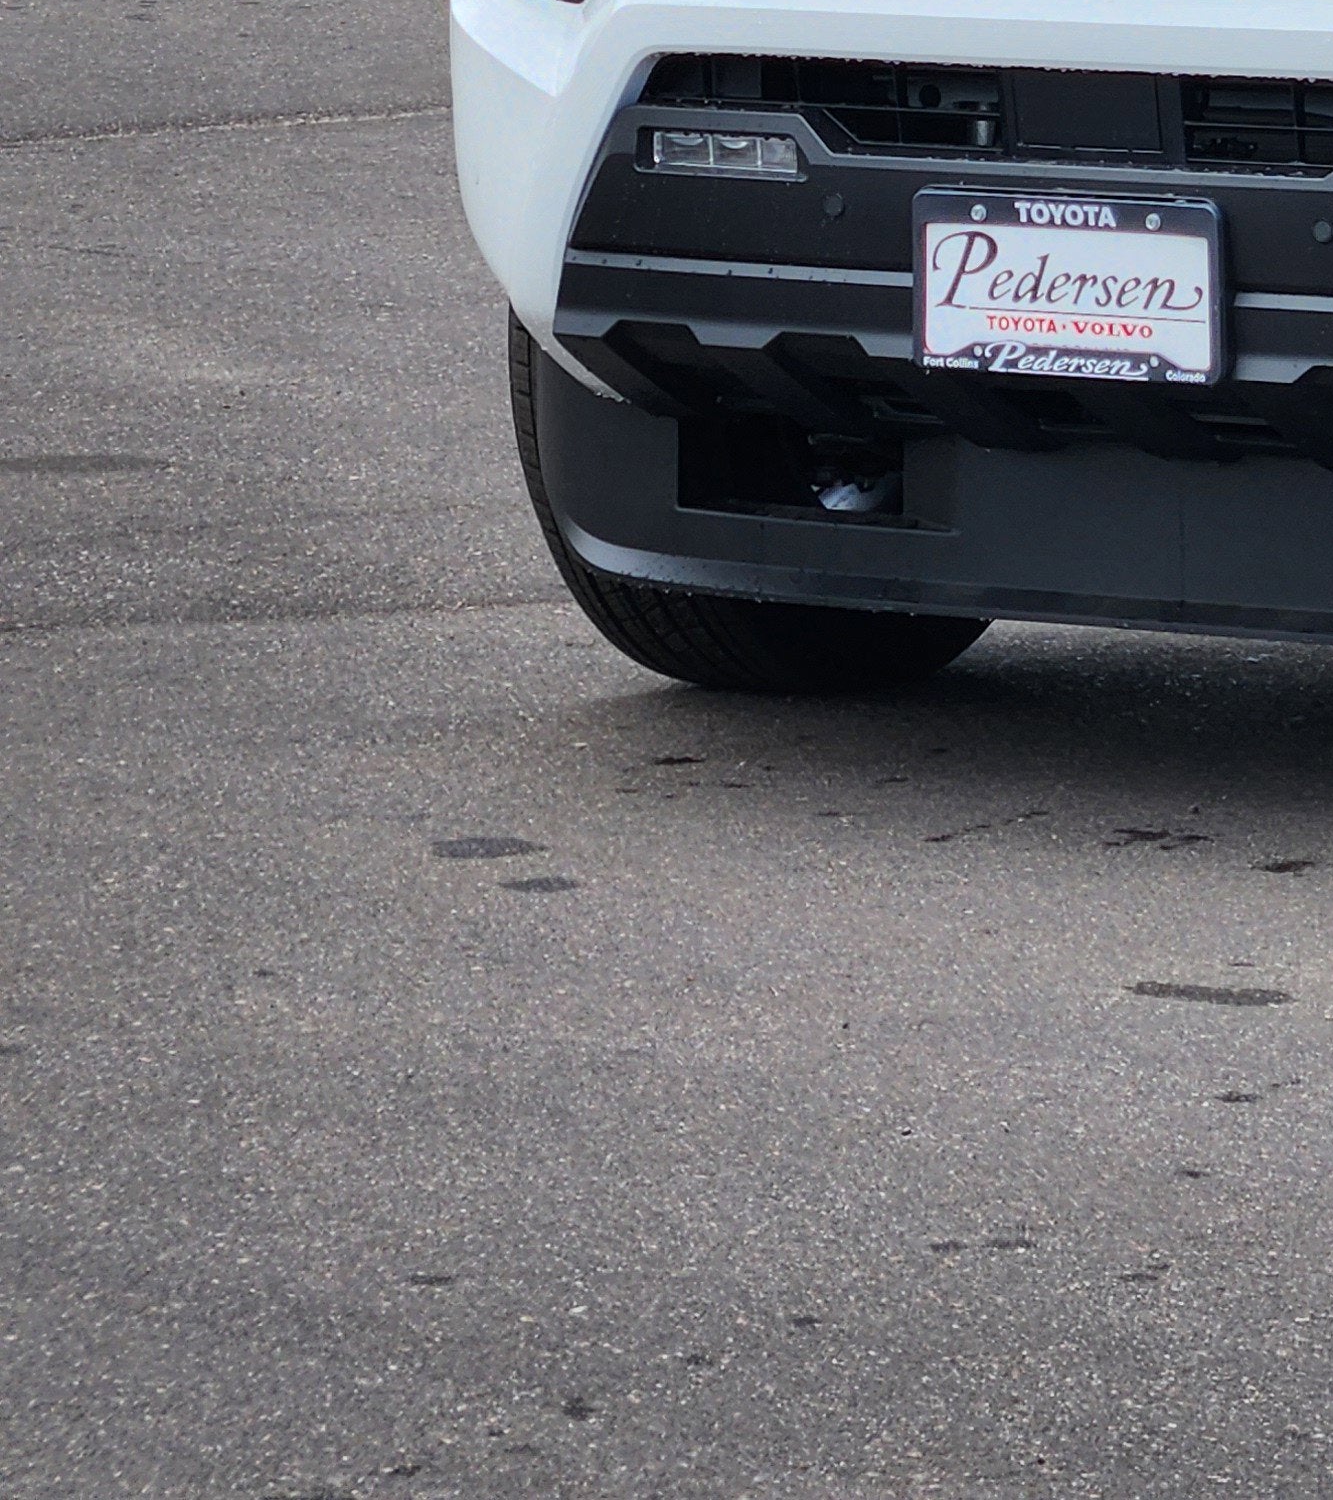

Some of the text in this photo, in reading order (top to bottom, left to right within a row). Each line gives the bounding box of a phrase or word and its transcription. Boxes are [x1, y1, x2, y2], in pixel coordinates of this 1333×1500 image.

[1013, 201, 1117, 229] TOYOTA
[931, 230, 1204, 311] Pedersen
[986, 315, 1153, 339] TOYOTA VOLVO
[984, 341, 1149, 377] Pedersen
